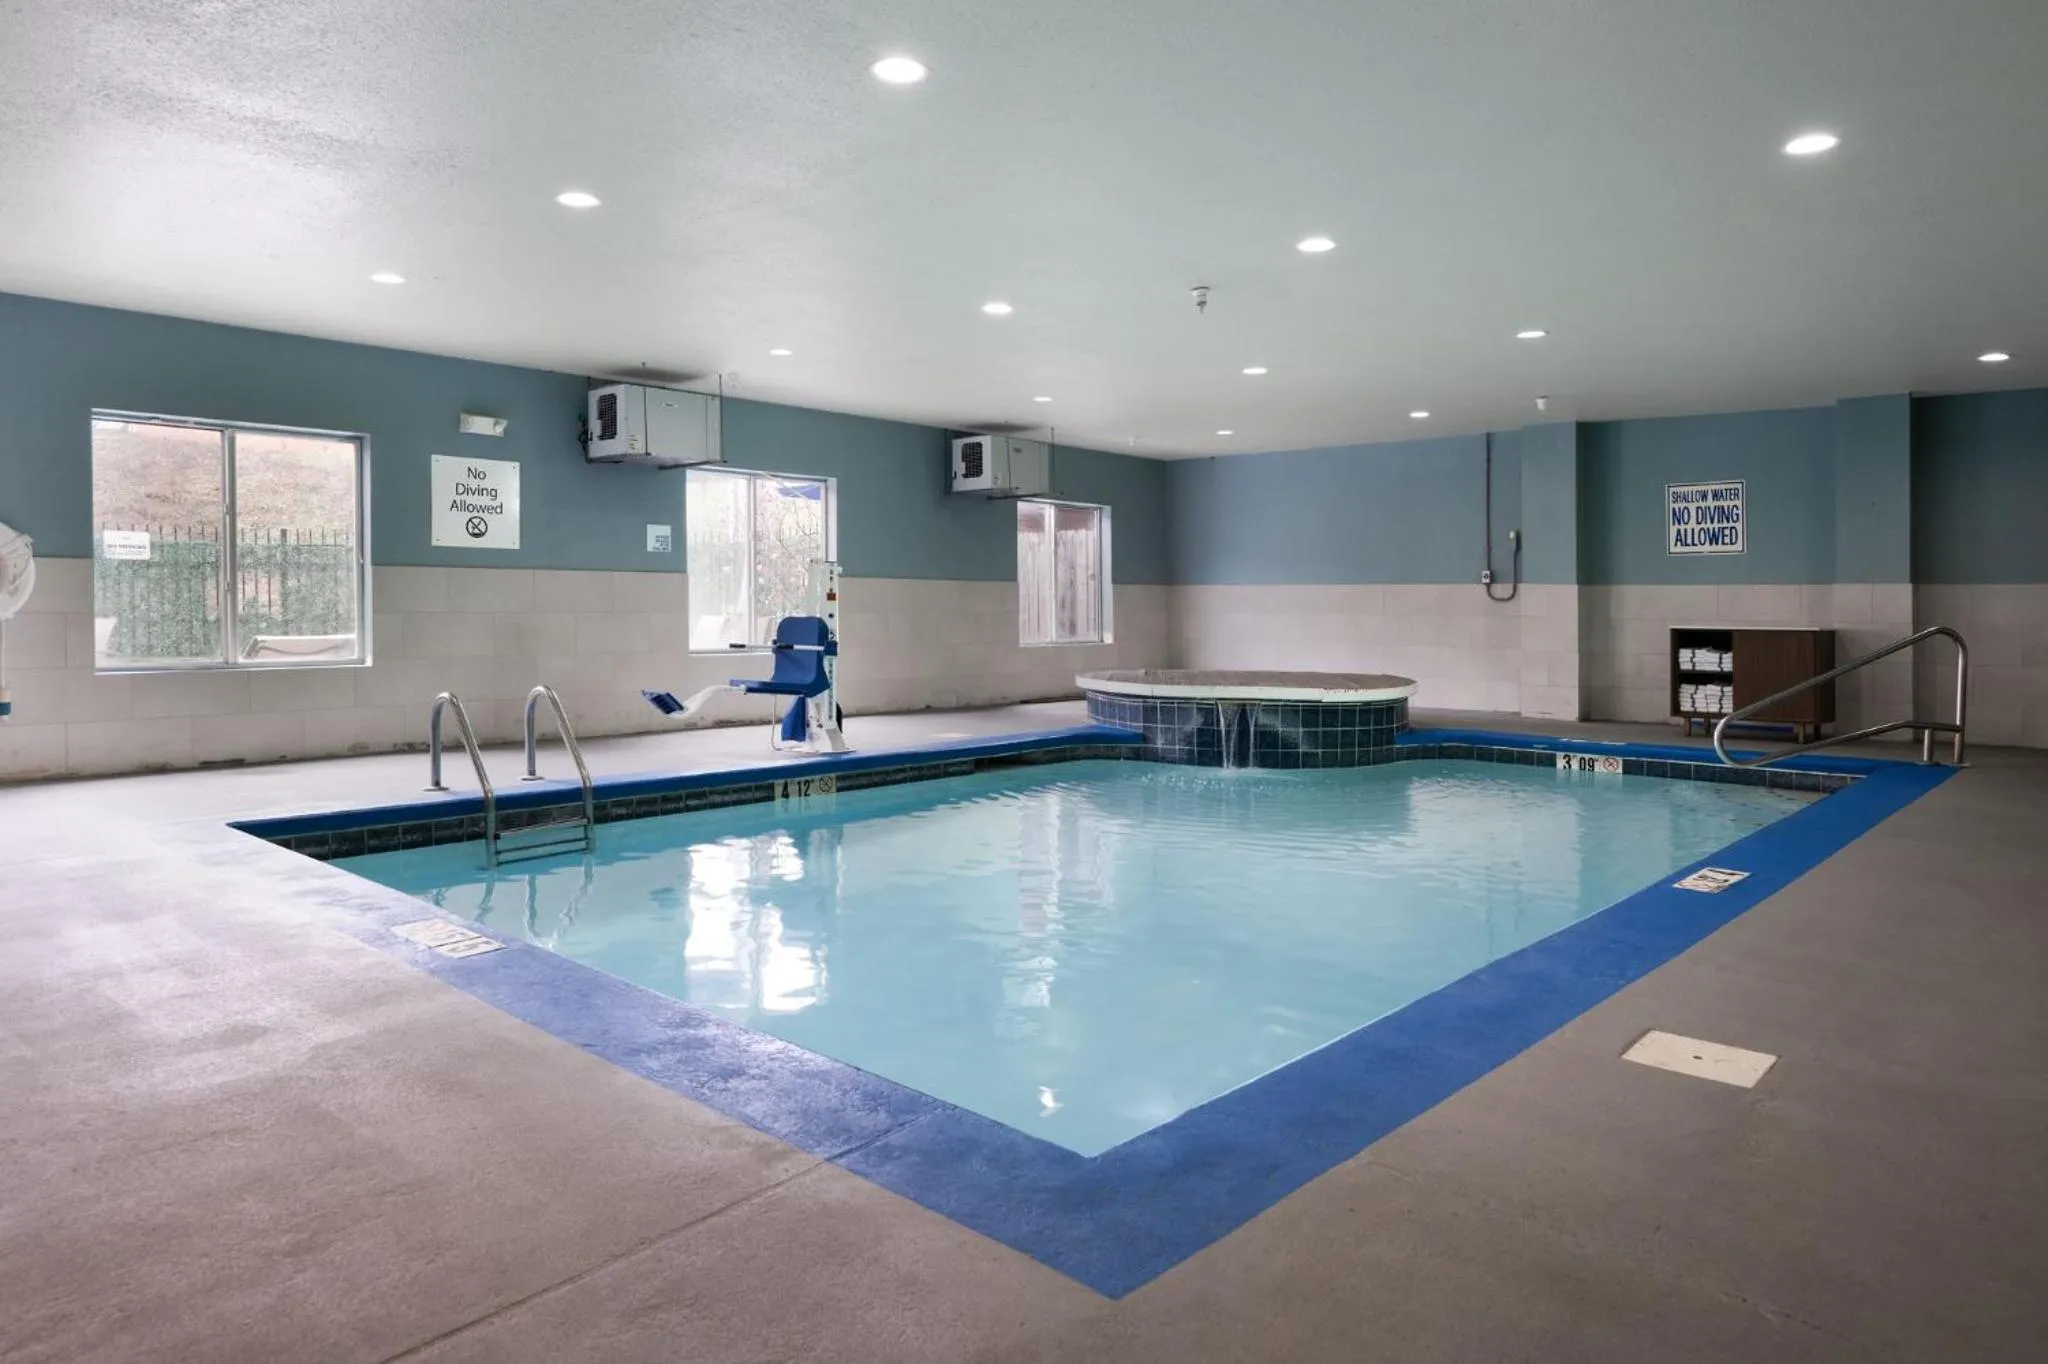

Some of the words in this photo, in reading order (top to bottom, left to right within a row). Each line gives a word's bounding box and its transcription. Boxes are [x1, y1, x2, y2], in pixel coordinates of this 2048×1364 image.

[467, 466, 487, 480] No
[455, 482, 498, 501] Diving
[1671, 490, 1709, 504] SHALLOW
[1711, 488, 1740, 502] WATER
[449, 499, 503, 515] Allowed
[1672, 506, 1691, 526] NO
[1695, 504, 1740, 525] DIVING
[1674, 526, 1739, 547] ALLOWED
